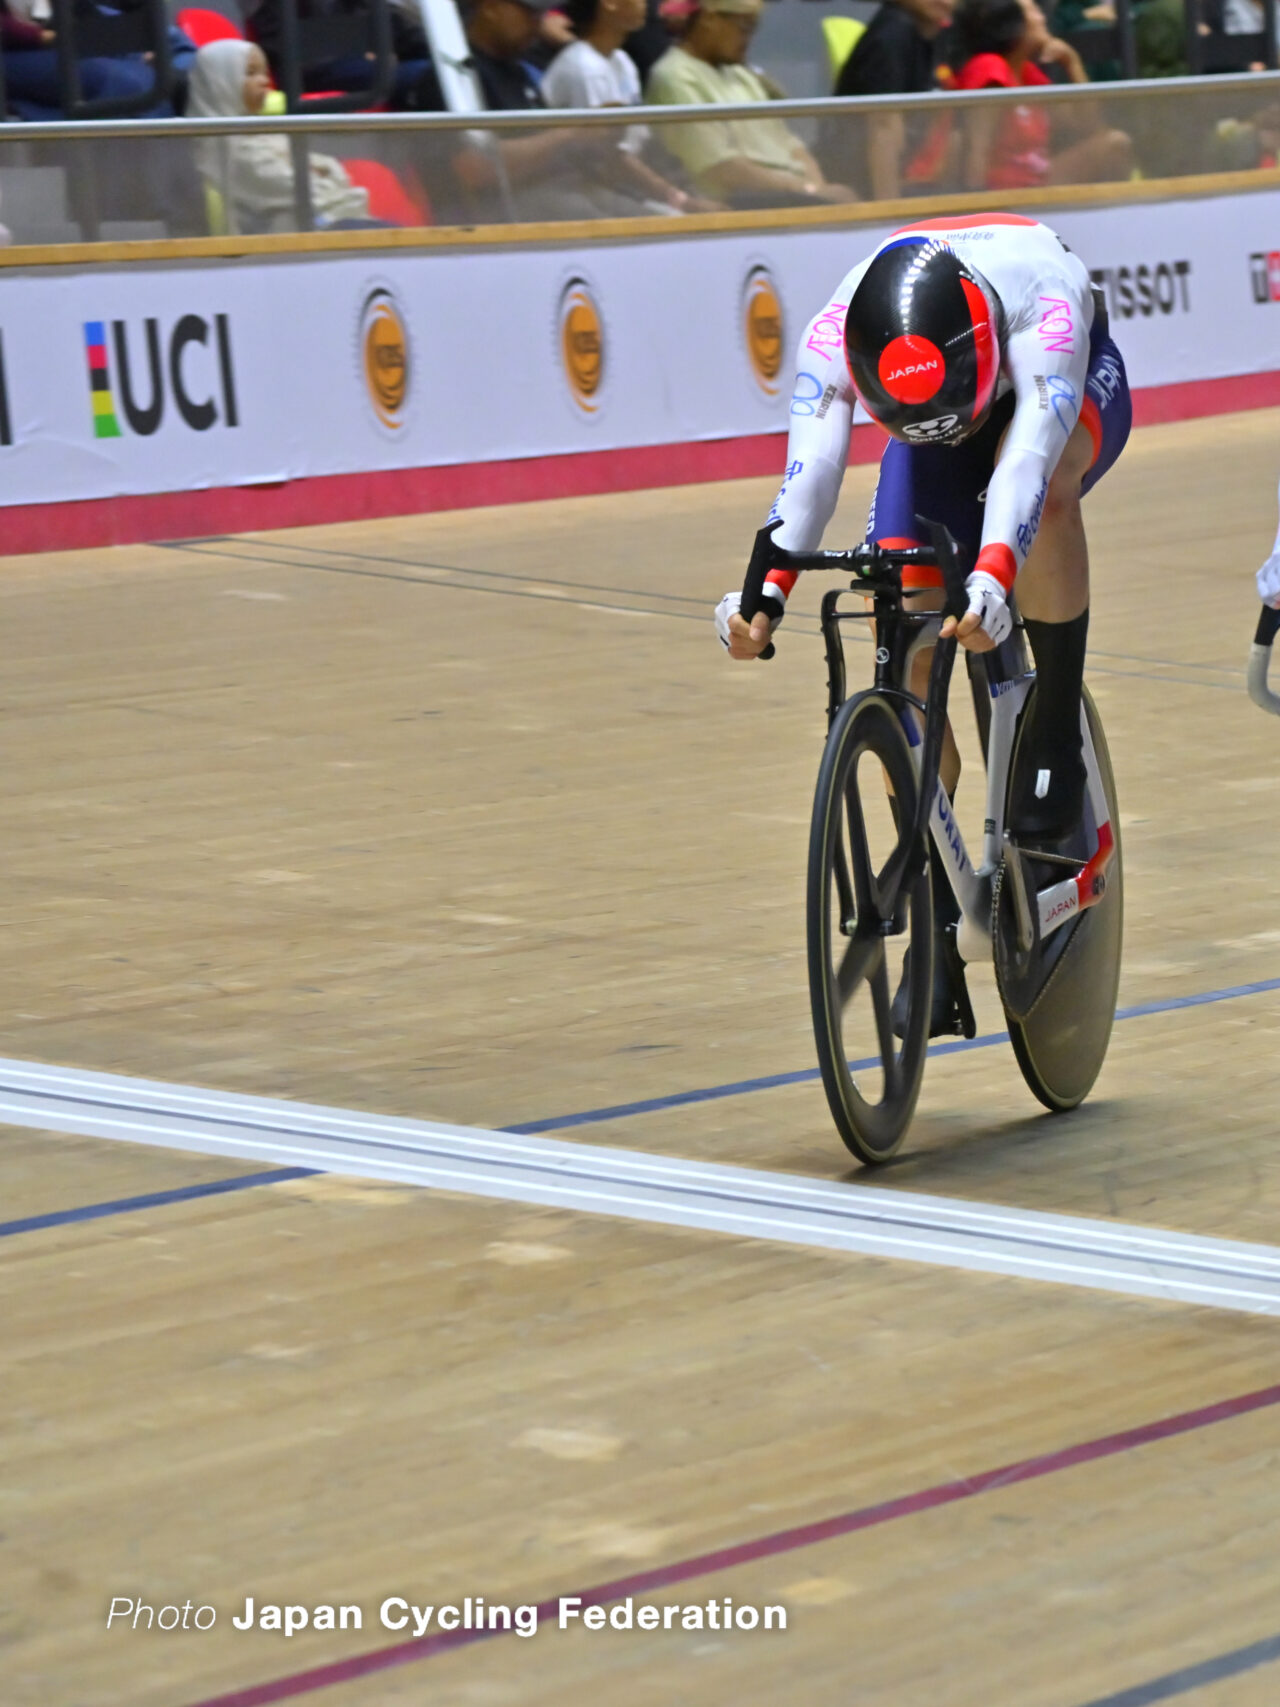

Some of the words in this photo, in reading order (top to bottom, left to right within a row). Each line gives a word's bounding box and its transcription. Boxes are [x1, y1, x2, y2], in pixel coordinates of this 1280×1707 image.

[111, 313, 239, 437] UCI
[886, 360, 938, 381] JAPAN
[815, 383, 838, 420] KEIRIN
[1033, 374, 1049, 411] KEIRIN
[1045, 897, 1076, 922] JAPAN
